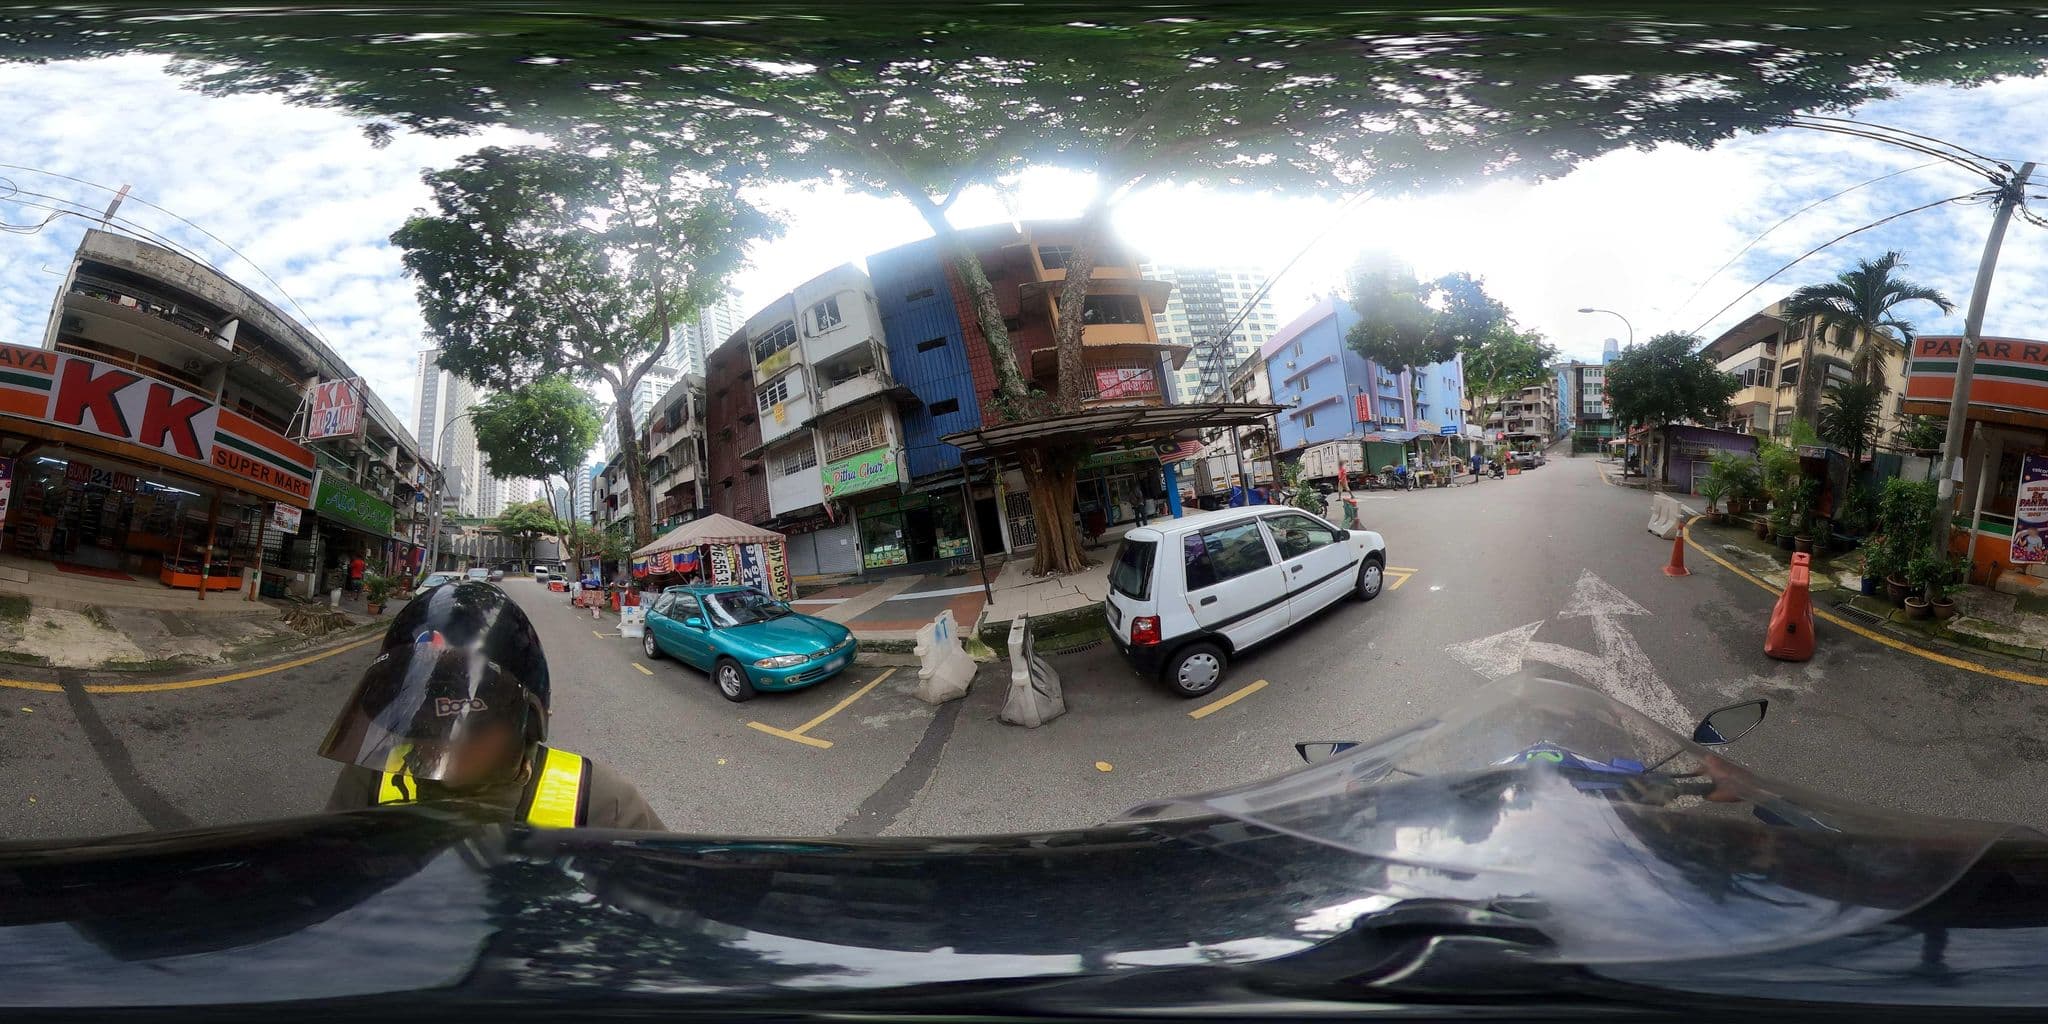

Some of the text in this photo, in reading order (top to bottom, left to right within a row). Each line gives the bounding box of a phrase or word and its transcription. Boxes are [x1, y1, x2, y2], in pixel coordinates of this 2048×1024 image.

[1922, 340, 2010, 358] PAAR
[315, 379, 356, 410] KK
[53, 358, 215, 460] KK
[324, 410, 338, 434] 24
[92, 468, 113, 487] 24
[216, 450, 270, 482] SUPER
[274, 471, 308, 495] MART
